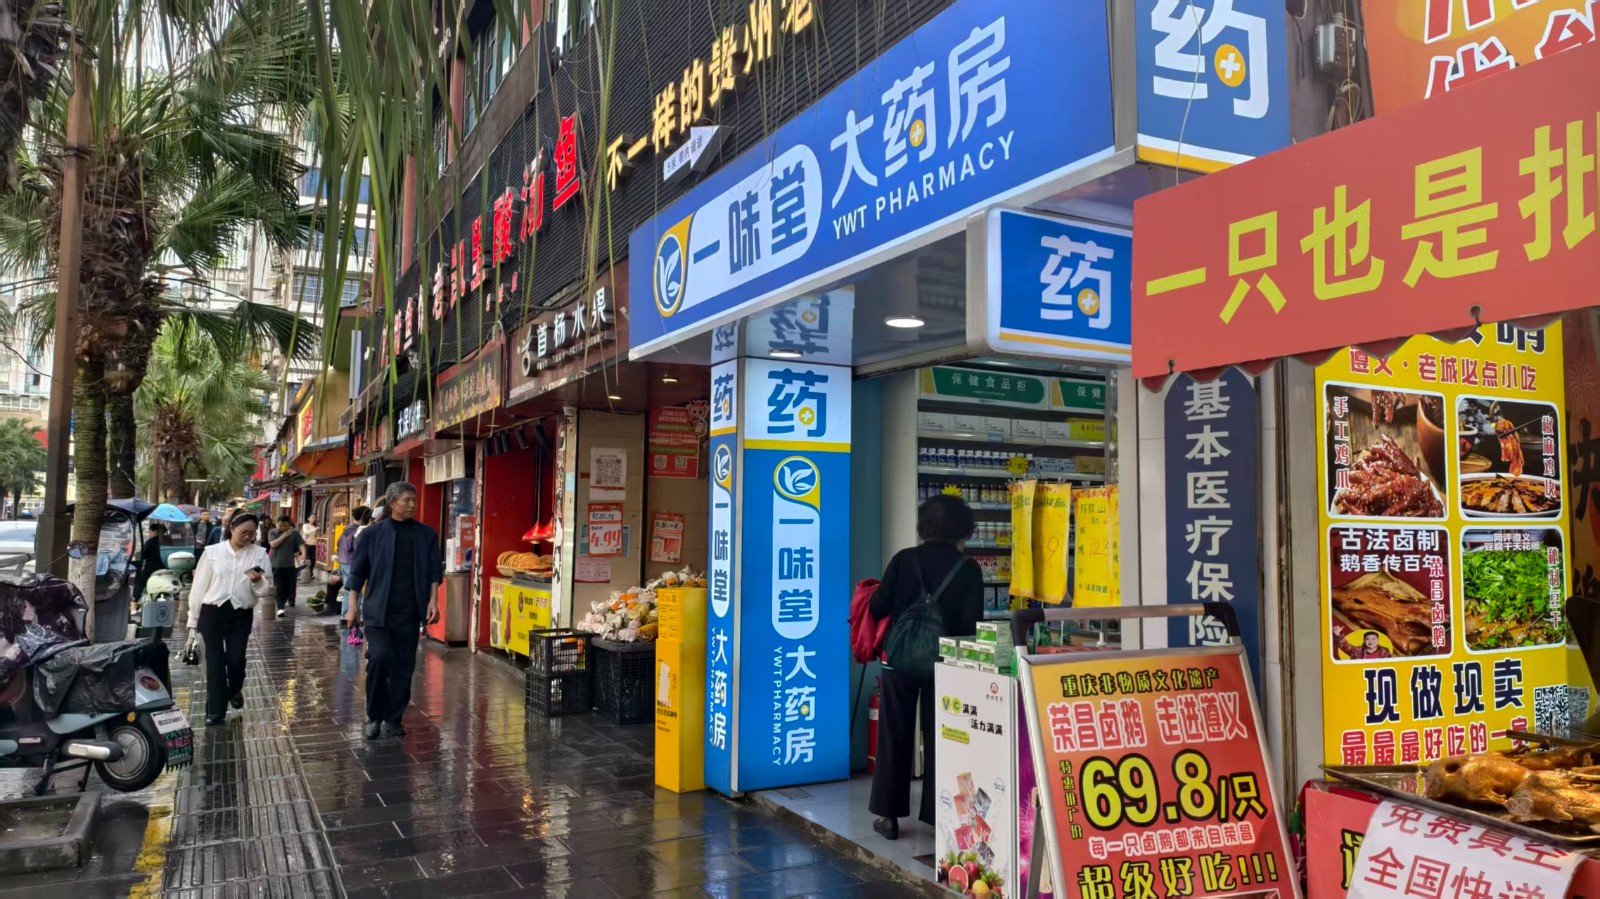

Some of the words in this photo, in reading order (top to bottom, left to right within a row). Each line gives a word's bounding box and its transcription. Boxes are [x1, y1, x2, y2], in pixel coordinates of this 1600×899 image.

[693, 159, 808, 275] 一味堂
[830, 15, 1011, 210] 大药房
[833, 205, 867, 240] YWT
[875, 130, 1015, 222] PHARMACY
[1040, 234, 1114, 330] 药
[713, 373, 734, 422] 药
[767, 368, 829, 438] 药
[951, 371, 1027, 392] 保健食品柜
[1333, 396, 1351, 490] 手工鸡爪
[714, 502, 729, 602] 一味堂
[1184, 378, 1235, 646] 基本医疗保险
[1339, 528, 1440, 552] 古法卤制
[778, 518, 814, 623] 一味堂
[1340, 553, 1437, 573] 鹅香传百年
[1429, 557, 1445, 648] 荣昌卤鹅
[714, 628, 729, 751] 大药房
[784, 644, 817, 765] 大药房
[1048, 699, 1147, 752] 荣昌卤鹅
[1154, 692, 1248, 744] 走进遵义
[1061, 667, 1220, 697] 重庆非物质文化遗产
[1363, 659, 1525, 725] 现做现卖
[970, 718, 1003, 736] 活力满满
[1059, 760, 1083, 840] 特惠推广价
[1079, 749, 1267, 831] 69.8/只
[1089, 821, 1255, 859] 每一只卤鹅都来自荣昌
